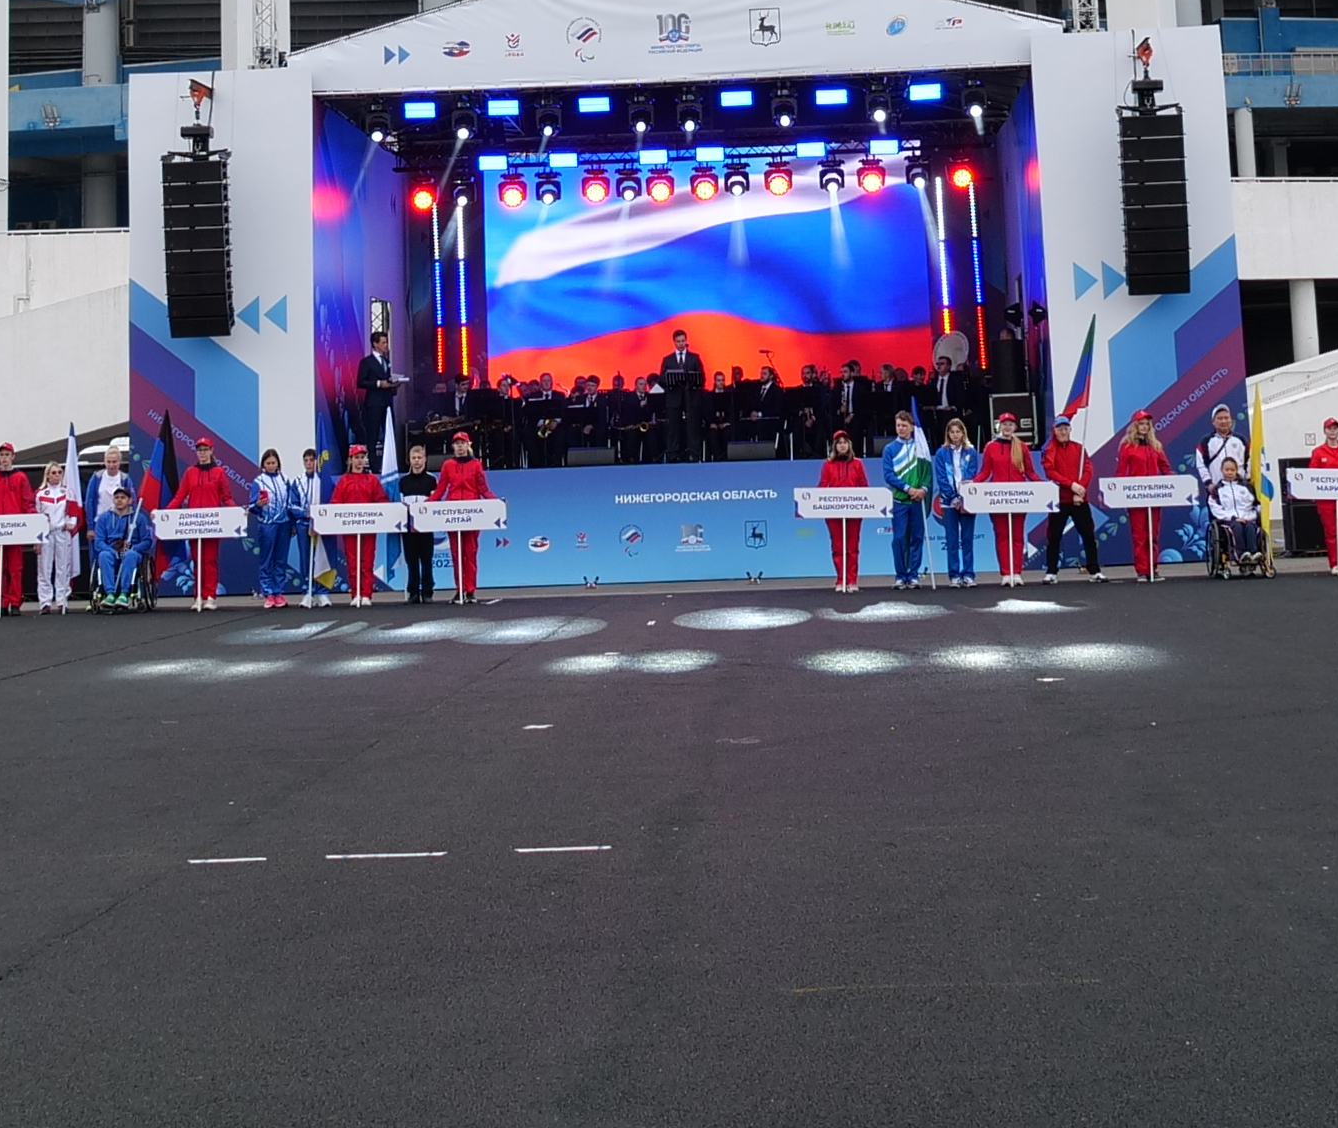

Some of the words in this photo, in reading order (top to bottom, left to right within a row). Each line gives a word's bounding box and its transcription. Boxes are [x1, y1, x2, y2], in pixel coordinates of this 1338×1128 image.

[1188, 367, 1229, 402] ОБЛАСТЬ
[1122, 482, 1175, 492] РЕСПУБЛИКА
[615, 490, 719, 504] НИЖЕГОРОДСКАЯ
[722, 489, 778, 501] ОБЛАСТЬ
[983, 489, 1035, 497] РЕСПУБЛИКА
[818, 495, 869, 503] РЕСПУБЛИКА
[989, 497, 1030, 505] ДАГЕСТАН
[178, 511, 219, 520] ДОНЕЦКАЯ
[334, 511, 384, 519] РЕСПУБЛИКА
[432, 507, 484, 516] РЕСПУБЛИКА
[178, 519, 220, 527] НАРОДНАЯ
[445, 515, 472, 524] АЛТАЙ
[175, 526, 223, 535] РЕСПУБЛИКА
